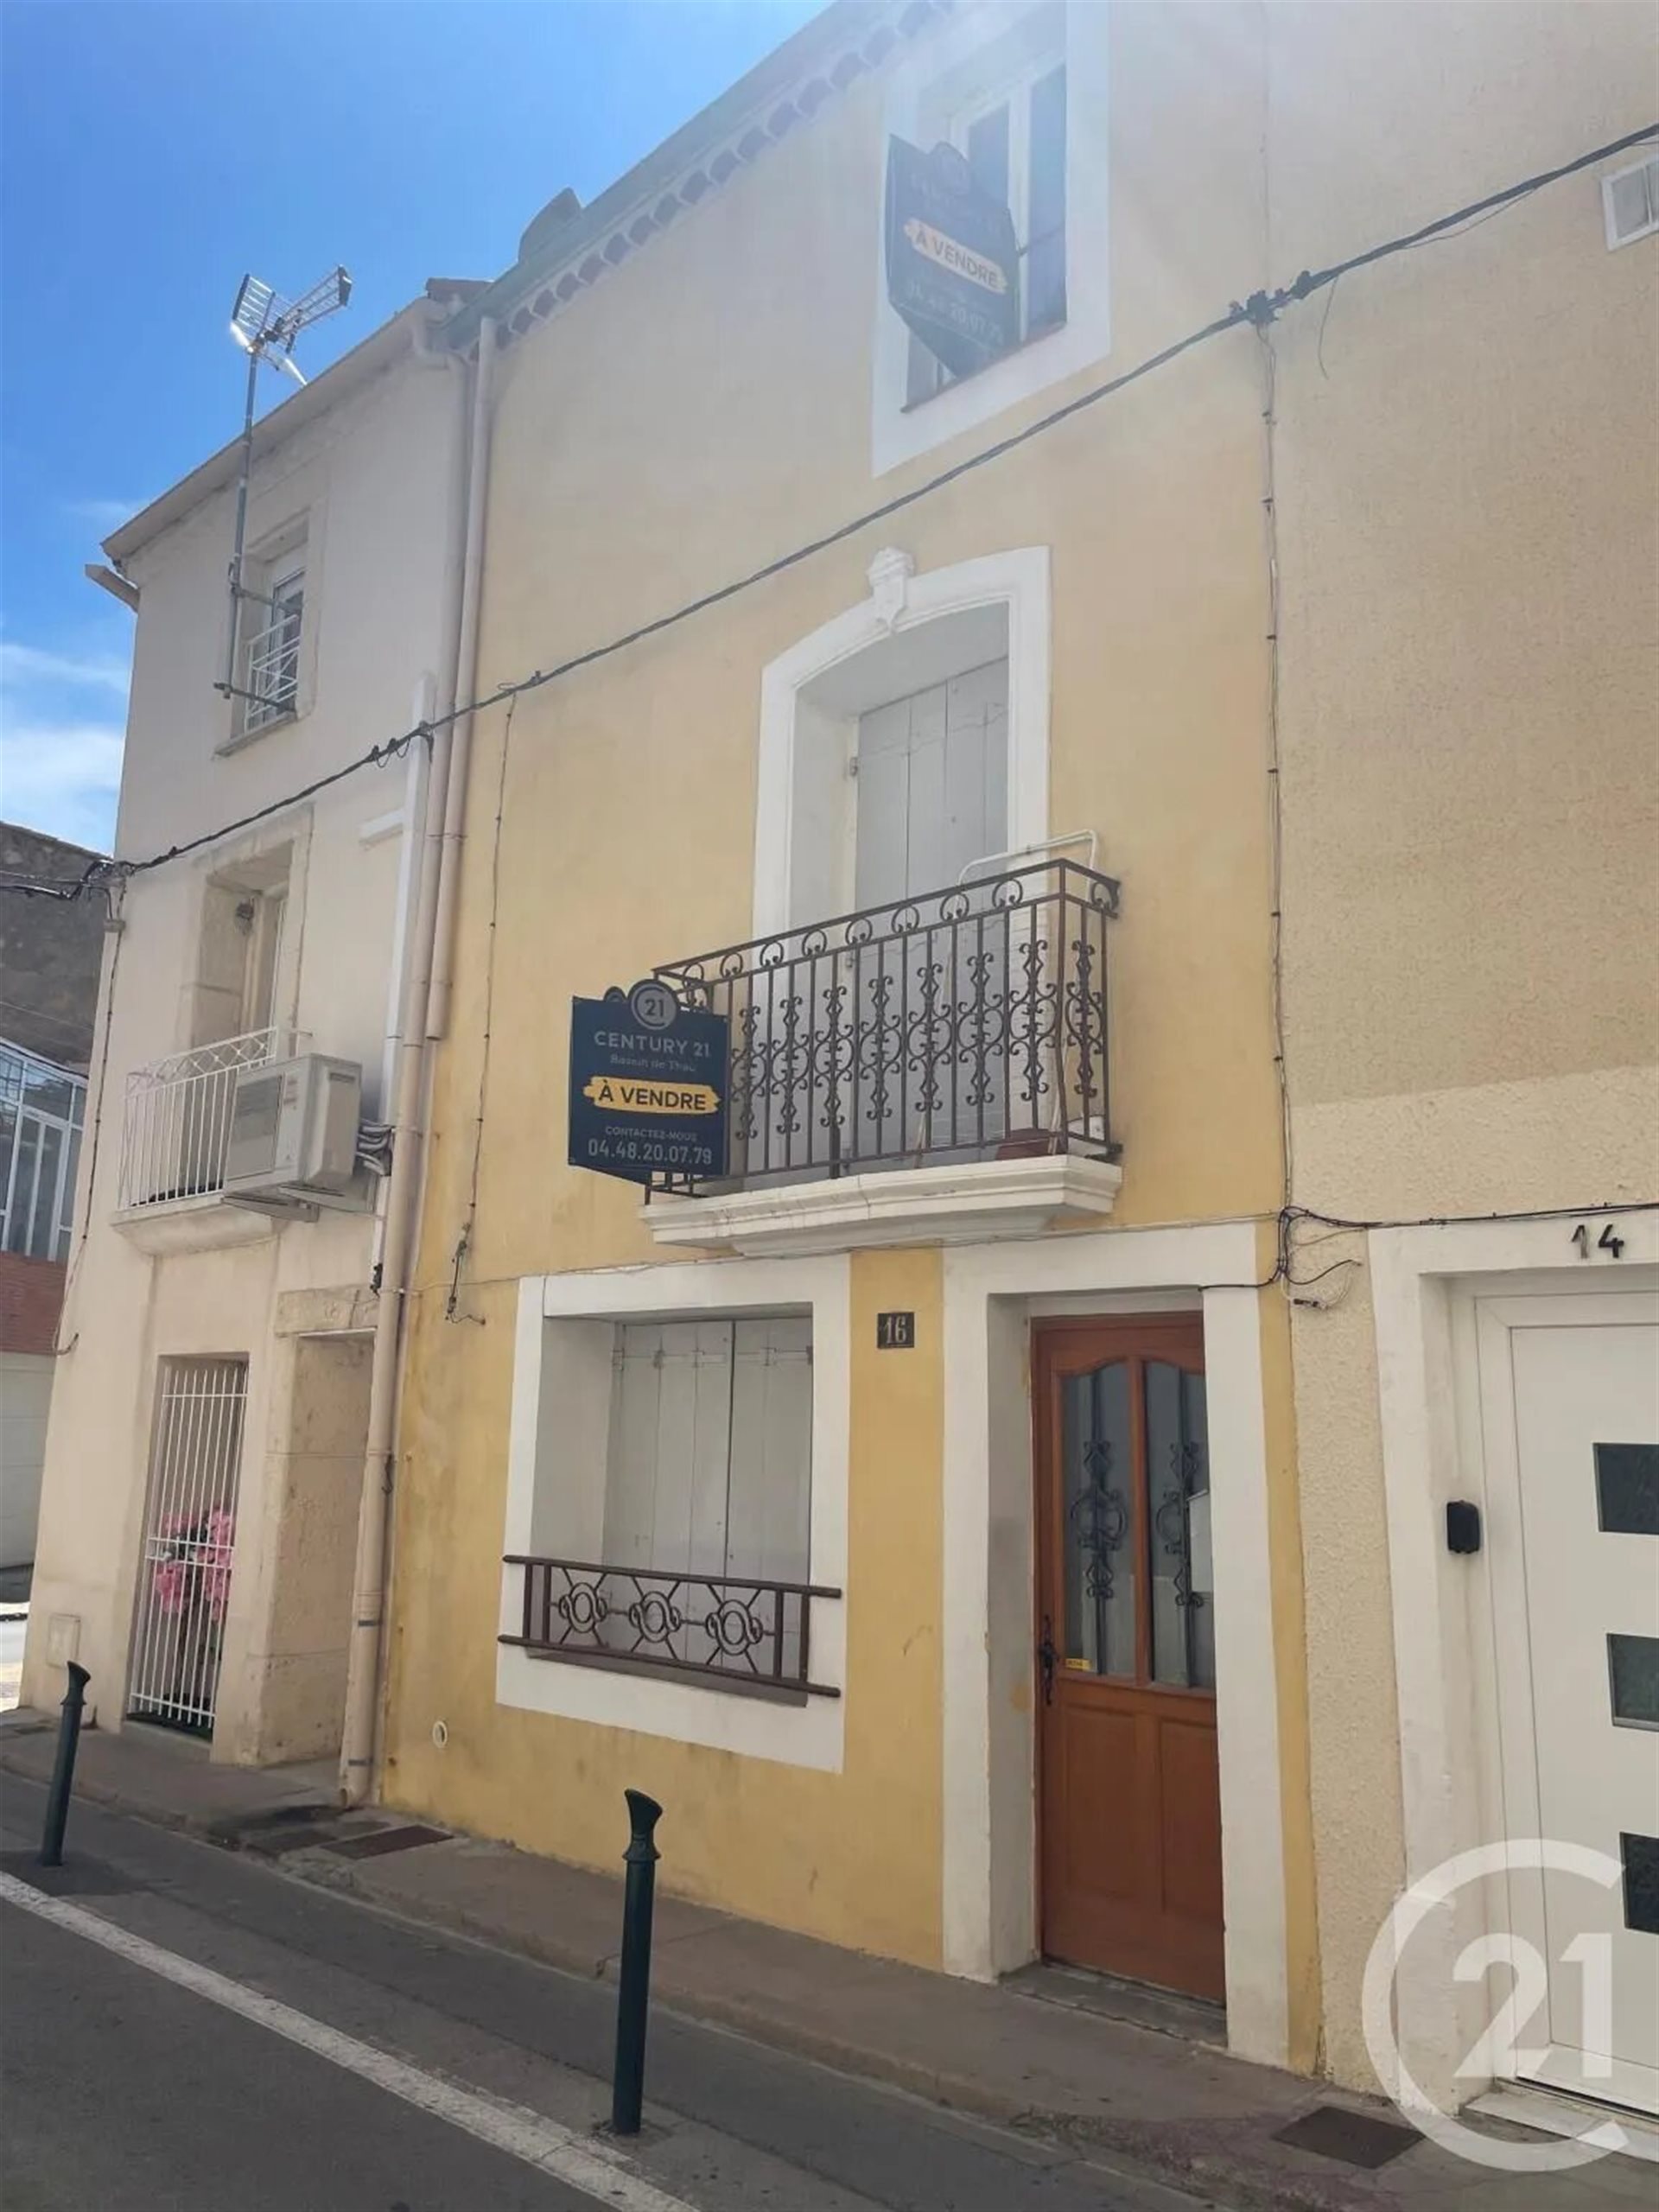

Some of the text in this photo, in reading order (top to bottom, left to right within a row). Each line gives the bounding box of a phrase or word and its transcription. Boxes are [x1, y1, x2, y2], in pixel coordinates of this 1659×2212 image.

[933, 239, 997, 288] VENDRE
[645, 999, 664, 1018] 21
[594, 1032, 710, 1057] CENTURY 21
[599, 1079, 706, 1110] À VENDRE
[1572, 1224, 1624, 1258] 14
[885, 1315, 906, 1344] 16
